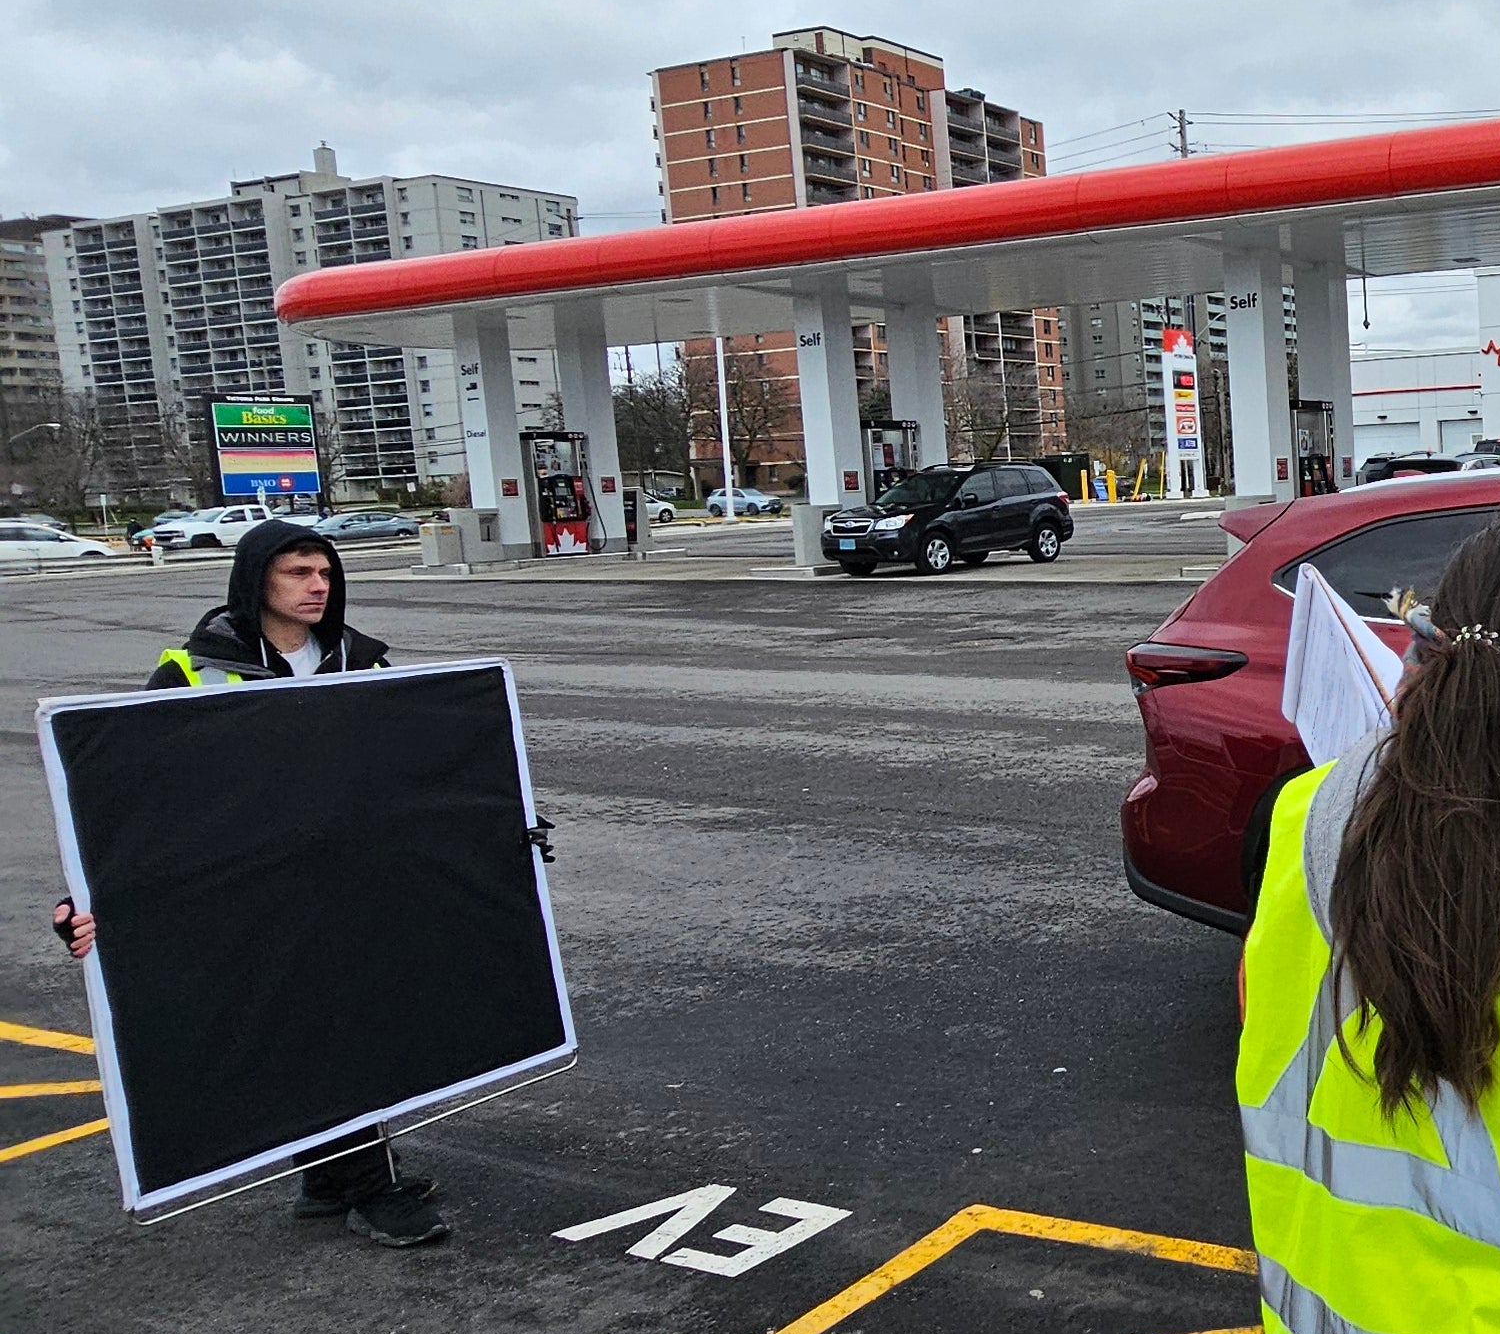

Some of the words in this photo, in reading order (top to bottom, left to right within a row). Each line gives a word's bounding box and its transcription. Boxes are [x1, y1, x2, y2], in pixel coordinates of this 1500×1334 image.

[1230, 292, 1257, 310] Self
[800, 332, 821, 347] Self
[461, 363, 479, 376] Self
[252, 406, 275, 415] food
[241, 411, 287, 425] Basics
[220, 432, 312, 443] WINNERS
[466, 429, 487, 438] Diesel
[250, 479, 276, 488] BMO
[551, 1183, 853, 1278] EV
